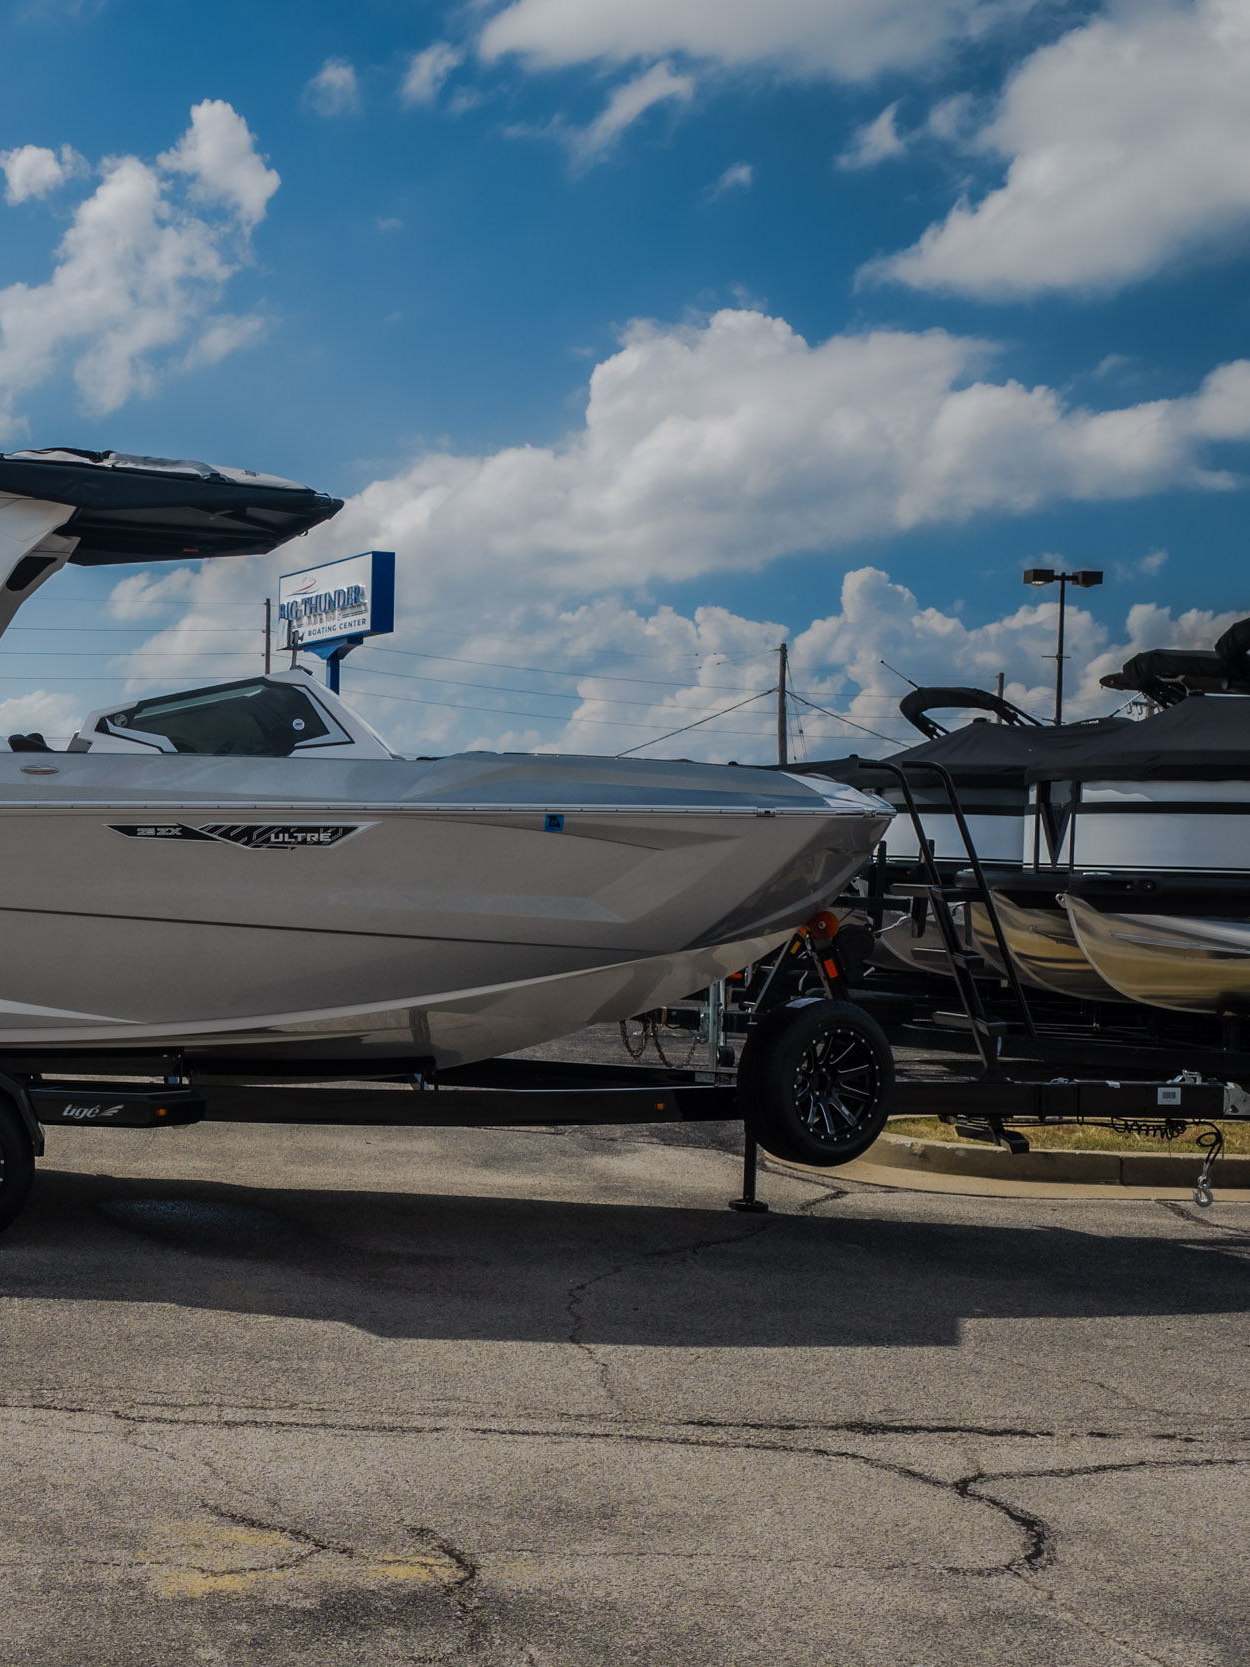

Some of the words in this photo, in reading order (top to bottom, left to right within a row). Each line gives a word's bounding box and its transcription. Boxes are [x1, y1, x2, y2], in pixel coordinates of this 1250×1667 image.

[279, 600, 299, 620] BIG
[301, 585, 361, 616] THUNDER
[308, 624, 337, 637] BOATING
[339, 618, 367, 631] CENTER
